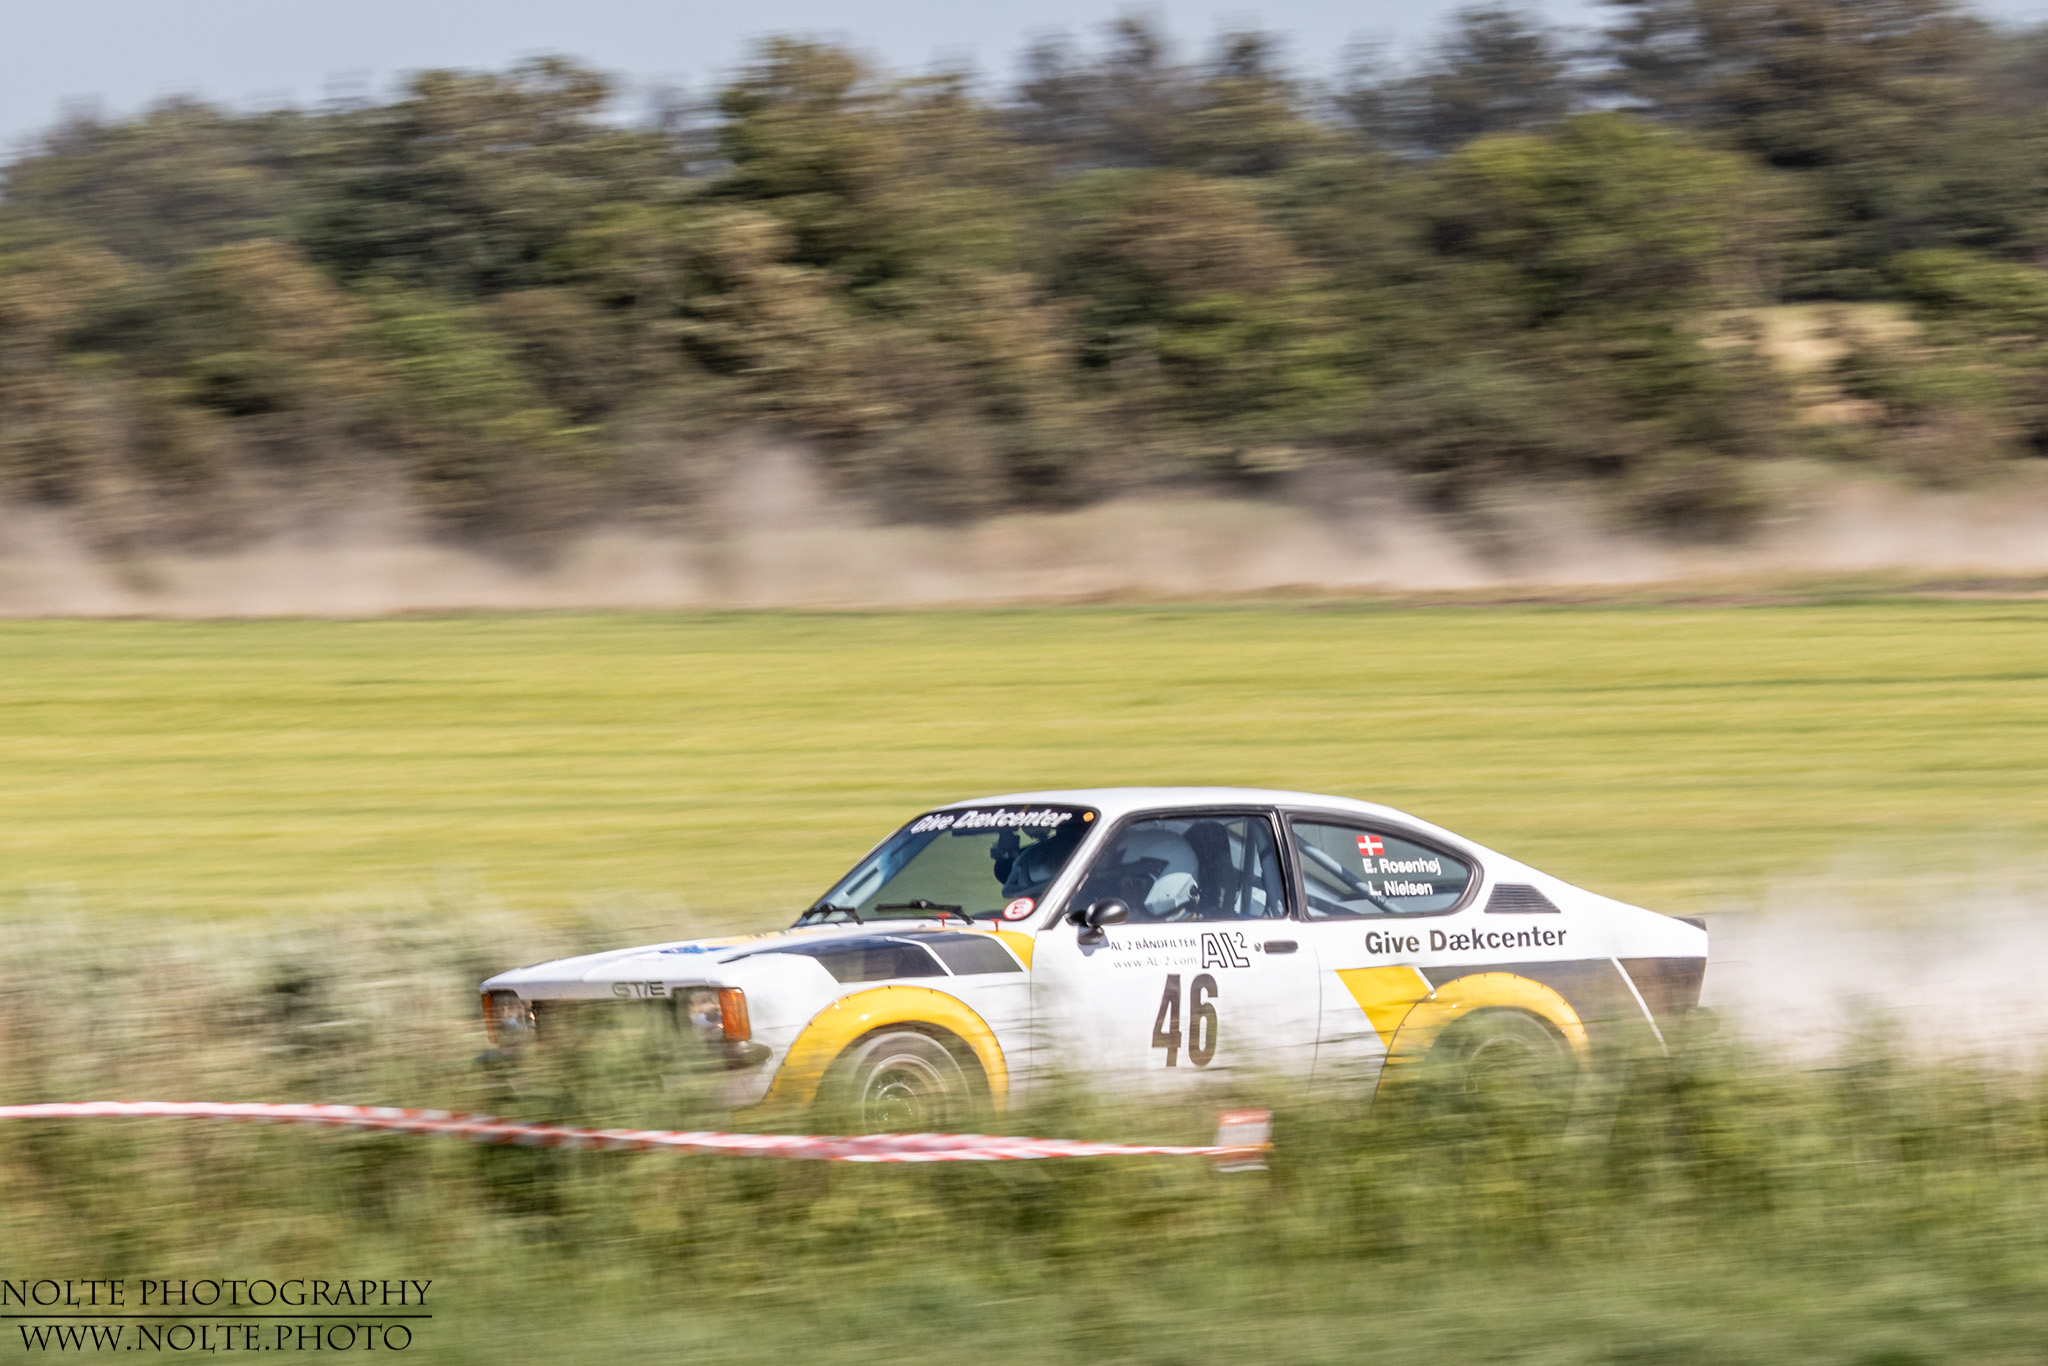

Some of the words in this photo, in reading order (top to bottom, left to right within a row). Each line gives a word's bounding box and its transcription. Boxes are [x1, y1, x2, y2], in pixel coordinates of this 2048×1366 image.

[910, 814, 955, 834] Give
[952, 808, 1072, 829] Dækcenter
[1362, 858, 1378, 874] E.
[1379, 857, 1442, 876] Rosenhøj
[1368, 880, 1382, 896] L.
[1384, 880, 1433, 896] Nielsen
[1365, 931, 1420, 954] Give
[1429, 926, 1567, 951] Dækcenter
[1151, 973, 1218, 1067] 46
